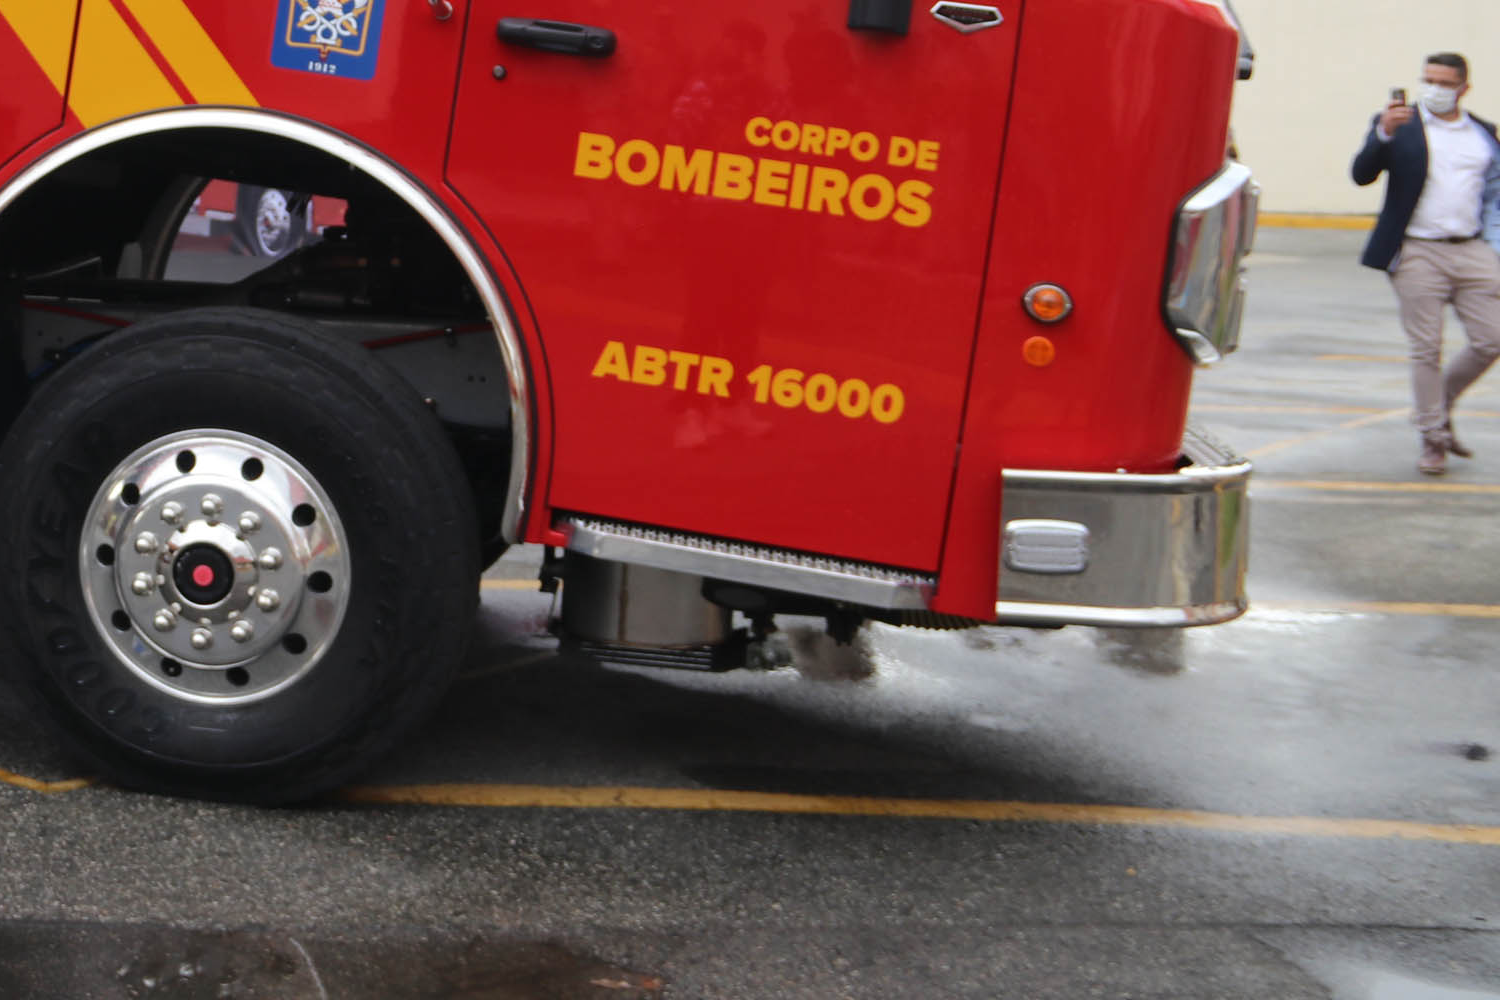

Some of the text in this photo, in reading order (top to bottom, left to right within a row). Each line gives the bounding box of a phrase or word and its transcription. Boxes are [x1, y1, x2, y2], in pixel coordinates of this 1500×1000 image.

[308, 61, 337, 75] 1912
[745, 116, 940, 172] CORPO DE
[574, 131, 934, 228] BOMBEIROS
[591, 340, 905, 424] ABTR 16000
